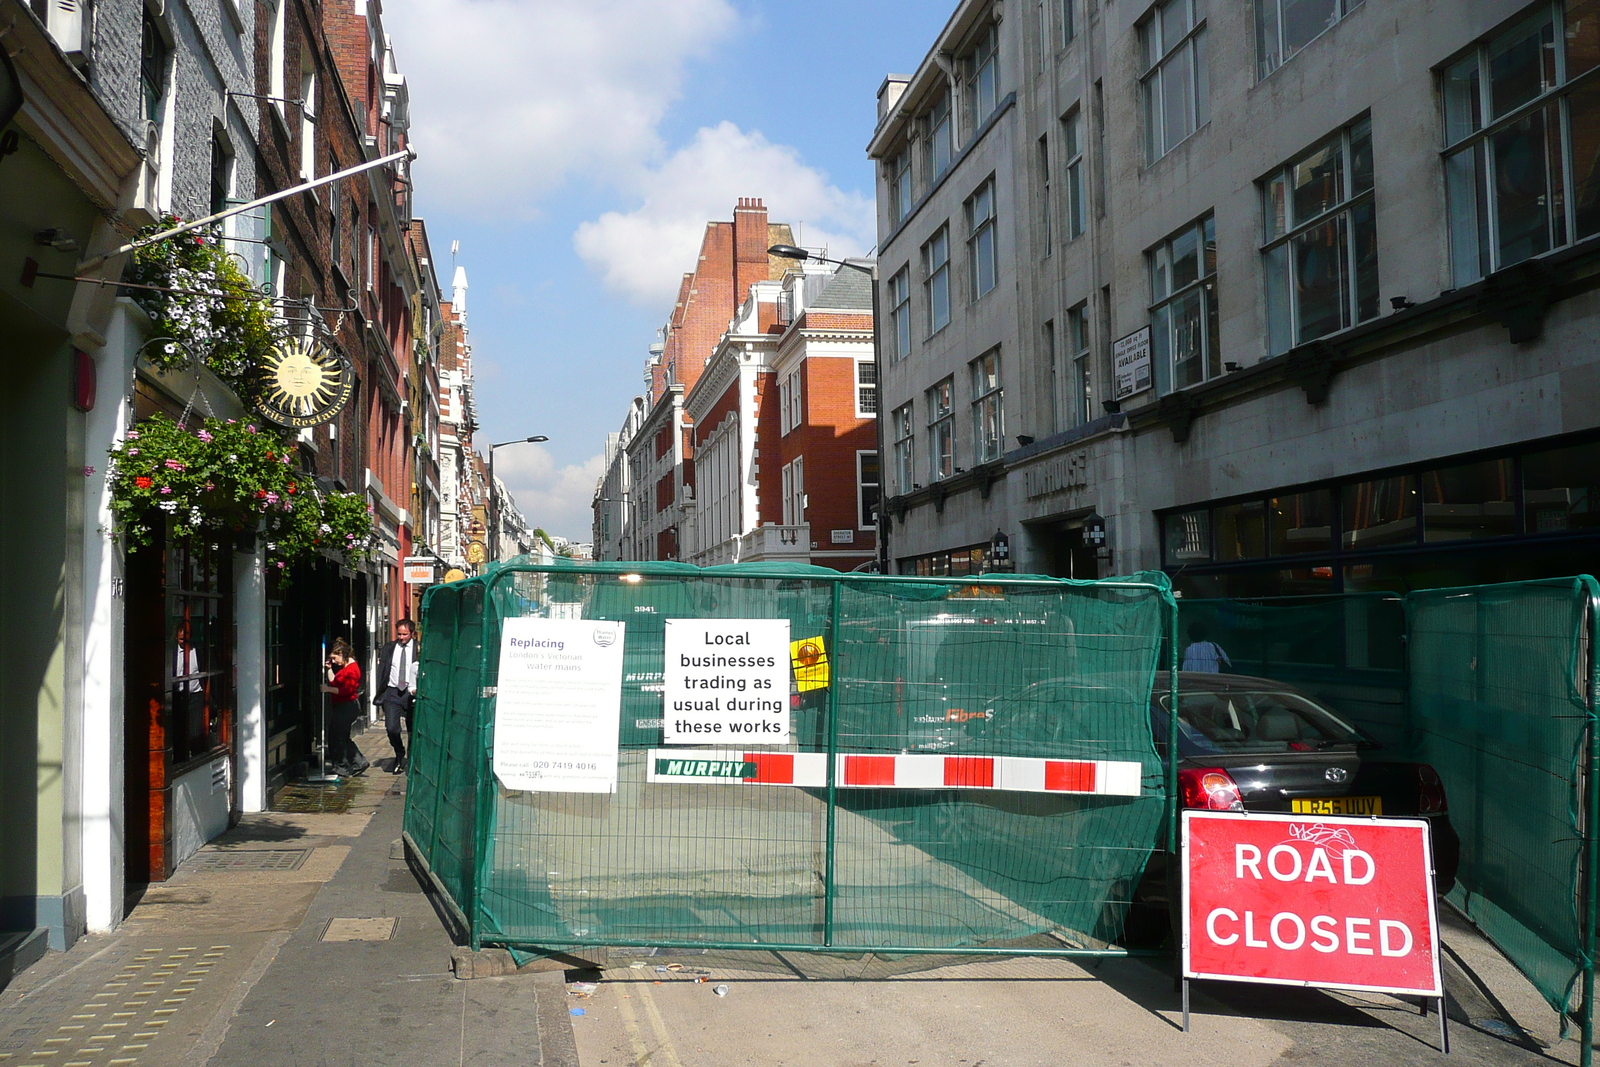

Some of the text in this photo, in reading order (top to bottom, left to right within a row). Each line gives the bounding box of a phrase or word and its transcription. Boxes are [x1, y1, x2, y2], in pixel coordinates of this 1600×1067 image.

[1118, 348, 1147, 369] AVAILABLE
[291, 384, 353, 427] Restaurant
[510, 638, 565, 651] Replacing
[704, 631, 750, 646] Local
[509, 651, 583, 661] London's Victorian
[680, 654, 775, 667] businesses
[526, 663, 582, 672] water mains
[684, 675, 772, 691] trading as
[673, 697, 783, 713] usual during
[675, 719, 781, 733] these works
[533, 761, 550, 769] 020
[552, 761, 573, 770] 7419
[576, 762, 597, 770] 4016
[666, 760, 746, 777] MURPHY
[1235, 843, 1376, 886] ROAD
[1205, 907, 1414, 958] CLOSED
